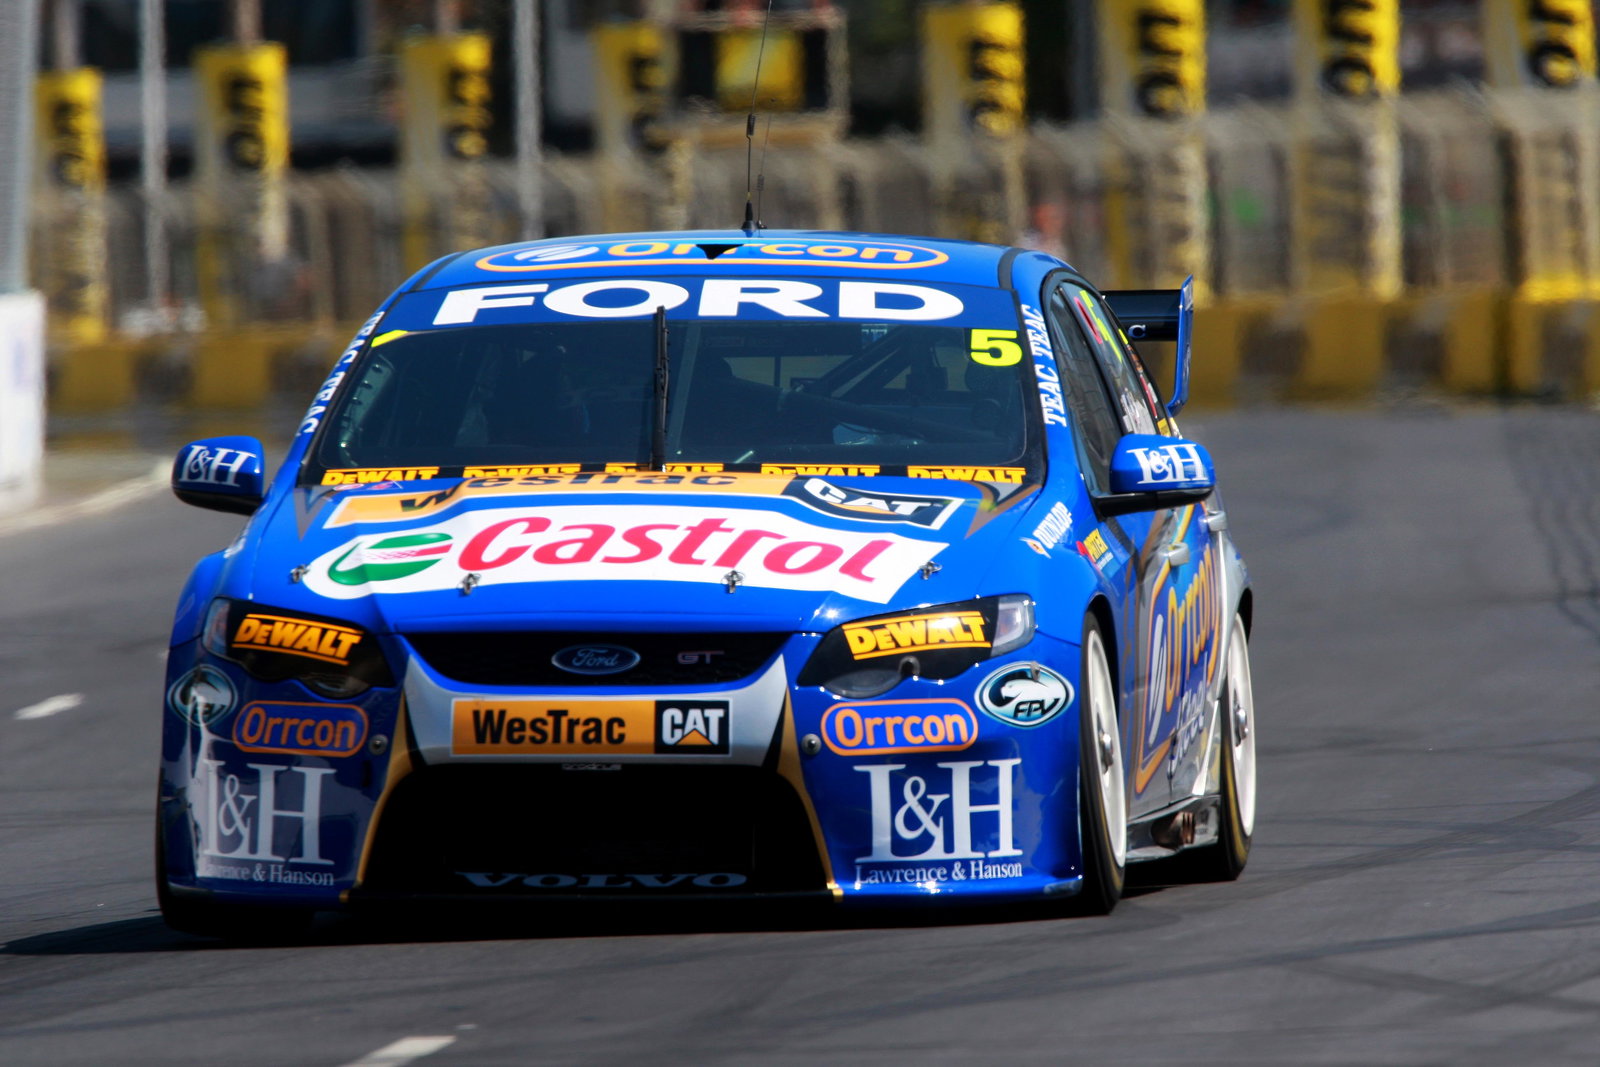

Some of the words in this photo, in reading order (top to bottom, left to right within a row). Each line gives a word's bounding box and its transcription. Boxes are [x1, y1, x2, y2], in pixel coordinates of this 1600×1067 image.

[608, 242, 912, 262] Orrcon
[433, 279, 964, 326] FORD
[970, 328, 1023, 367] 5
[1021, 304, 1056, 360] TEAC
[1035, 364, 1068, 427] TEAC
[179, 445, 257, 487] L&H
[1126, 443, 1208, 485] L&H
[804, 477, 931, 516] CAT
[458, 516, 894, 583] Castrol
[572, 648, 619, 667] Ford
[677, 651, 725, 665] GT
[241, 706, 357, 749] Orrcon
[472, 709, 626, 746] WesTrac
[661, 707, 725, 746] CAT
[834, 708, 969, 748] Orrcon
[1013, 699, 1060, 719] FPV
[853, 757, 1023, 864] L&H
[252, 862, 266, 882] &
[269, 864, 335, 886] Hanson
[455, 872, 747, 888] VOLVO
[855, 864, 948, 885] Lawrence
[951, 861, 965, 880] &
[969, 859, 1023, 880] Hanson
